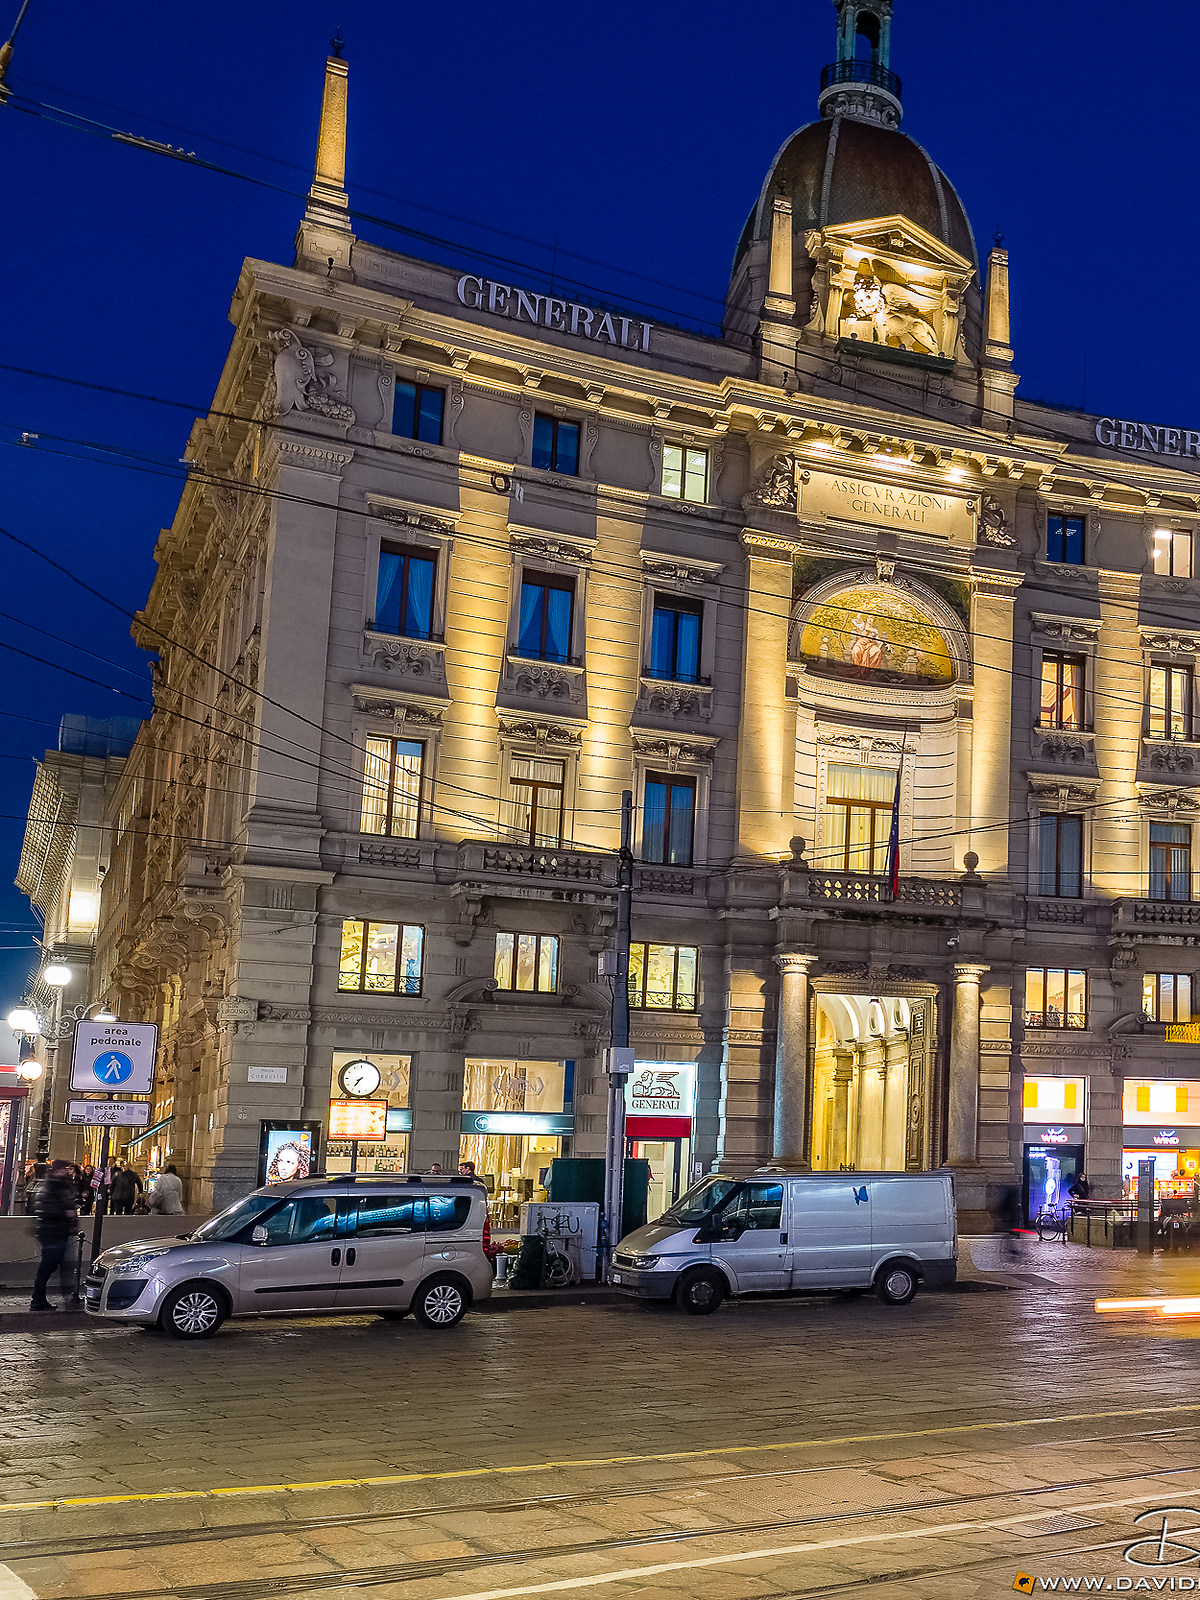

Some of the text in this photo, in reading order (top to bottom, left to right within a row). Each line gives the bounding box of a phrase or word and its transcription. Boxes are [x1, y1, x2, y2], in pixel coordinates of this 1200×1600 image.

[456, 273, 655, 354] GENERALI
[851, 499, 925, 522] GENERALI
[104, 1027, 128, 1036] area
[90, 1037, 142, 1047] pedonale
[631, 1099, 680, 1110] GENERALI
[1040, 1134, 1069, 1143] WIND
[1153, 1136, 1180, 1145] WIND
